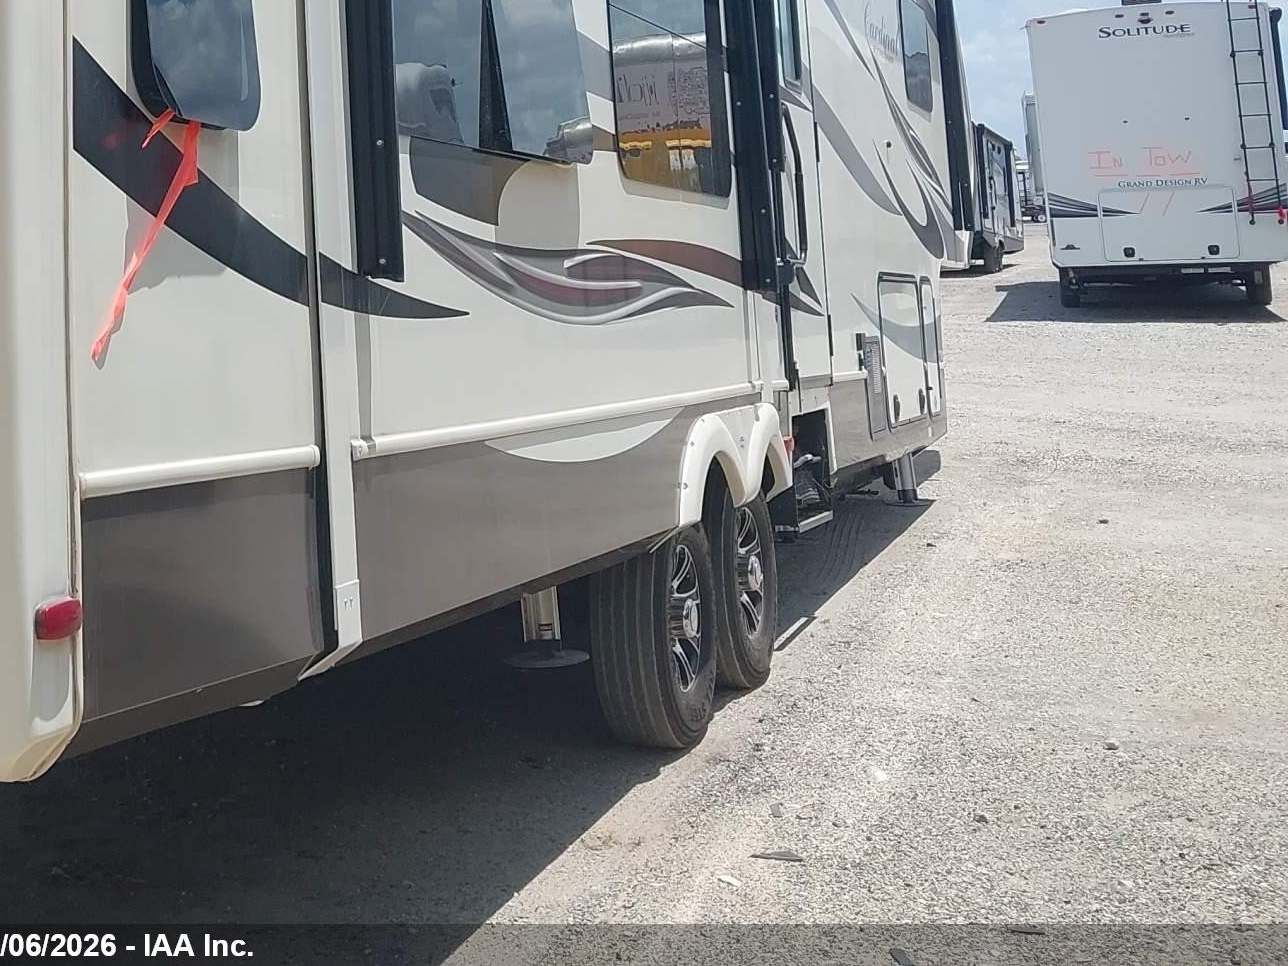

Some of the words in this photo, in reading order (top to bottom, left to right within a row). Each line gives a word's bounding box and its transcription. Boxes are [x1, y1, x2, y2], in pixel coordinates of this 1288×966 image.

[1098, 23, 1192, 39] SOLITUDE
[1118, 179, 1153, 188] GRAND
[1155, 178, 1192, 187] DESIGN
[1194, 177, 1208, 186] RV
